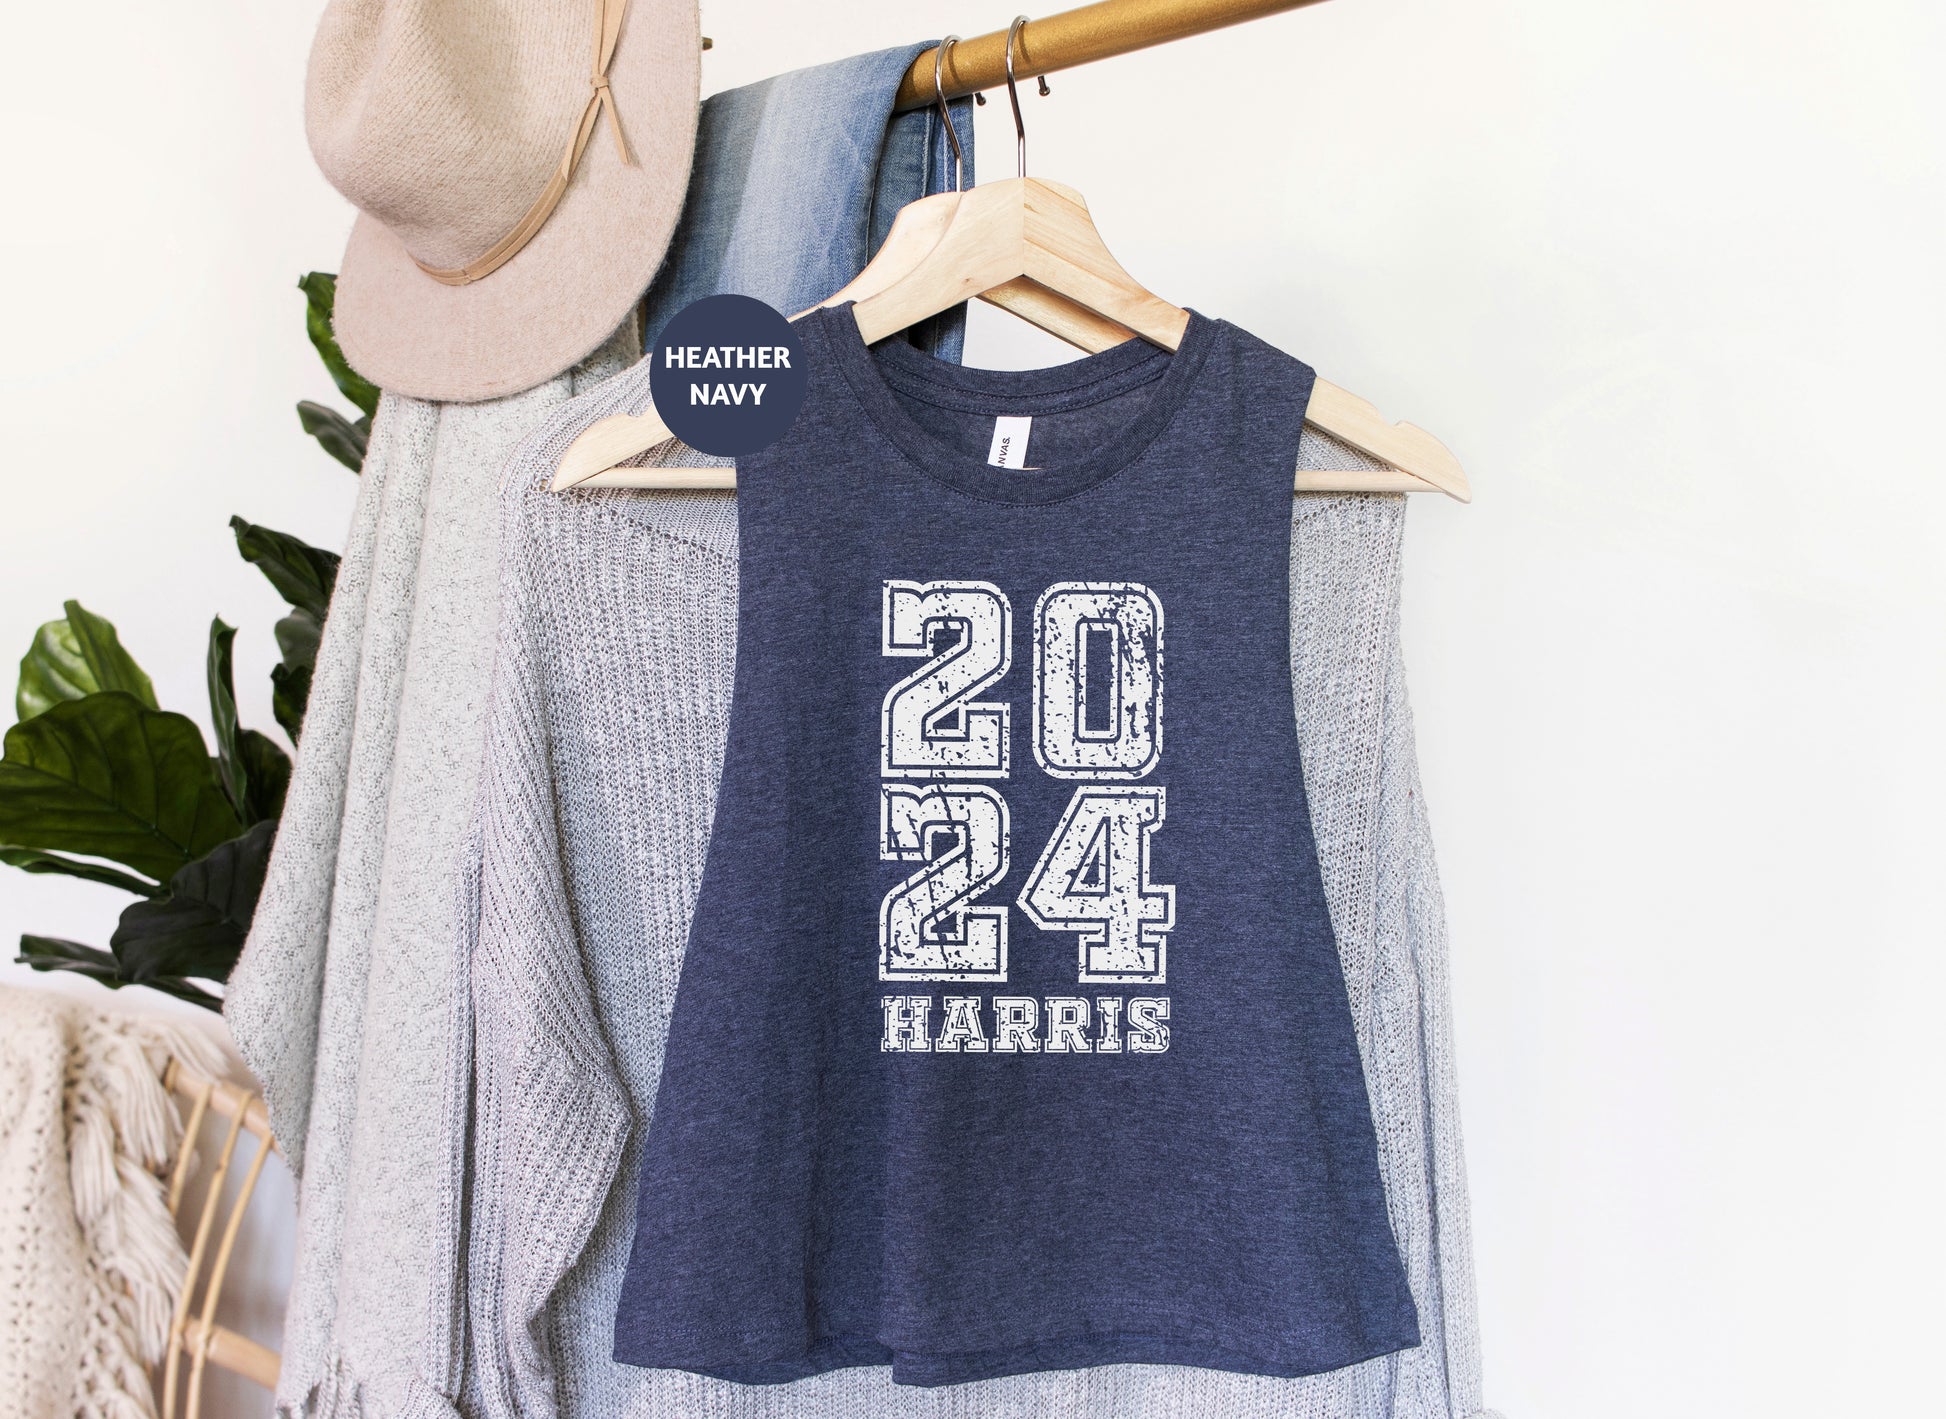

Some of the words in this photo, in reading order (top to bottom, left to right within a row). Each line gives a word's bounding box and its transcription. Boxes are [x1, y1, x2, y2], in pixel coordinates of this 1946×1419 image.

[997, 437, 1011, 469] NVAS.
[881, 580, 1165, 780] 20
[879, 783, 1176, 985] 24
[880, 996, 1171, 1054] HARRIS
